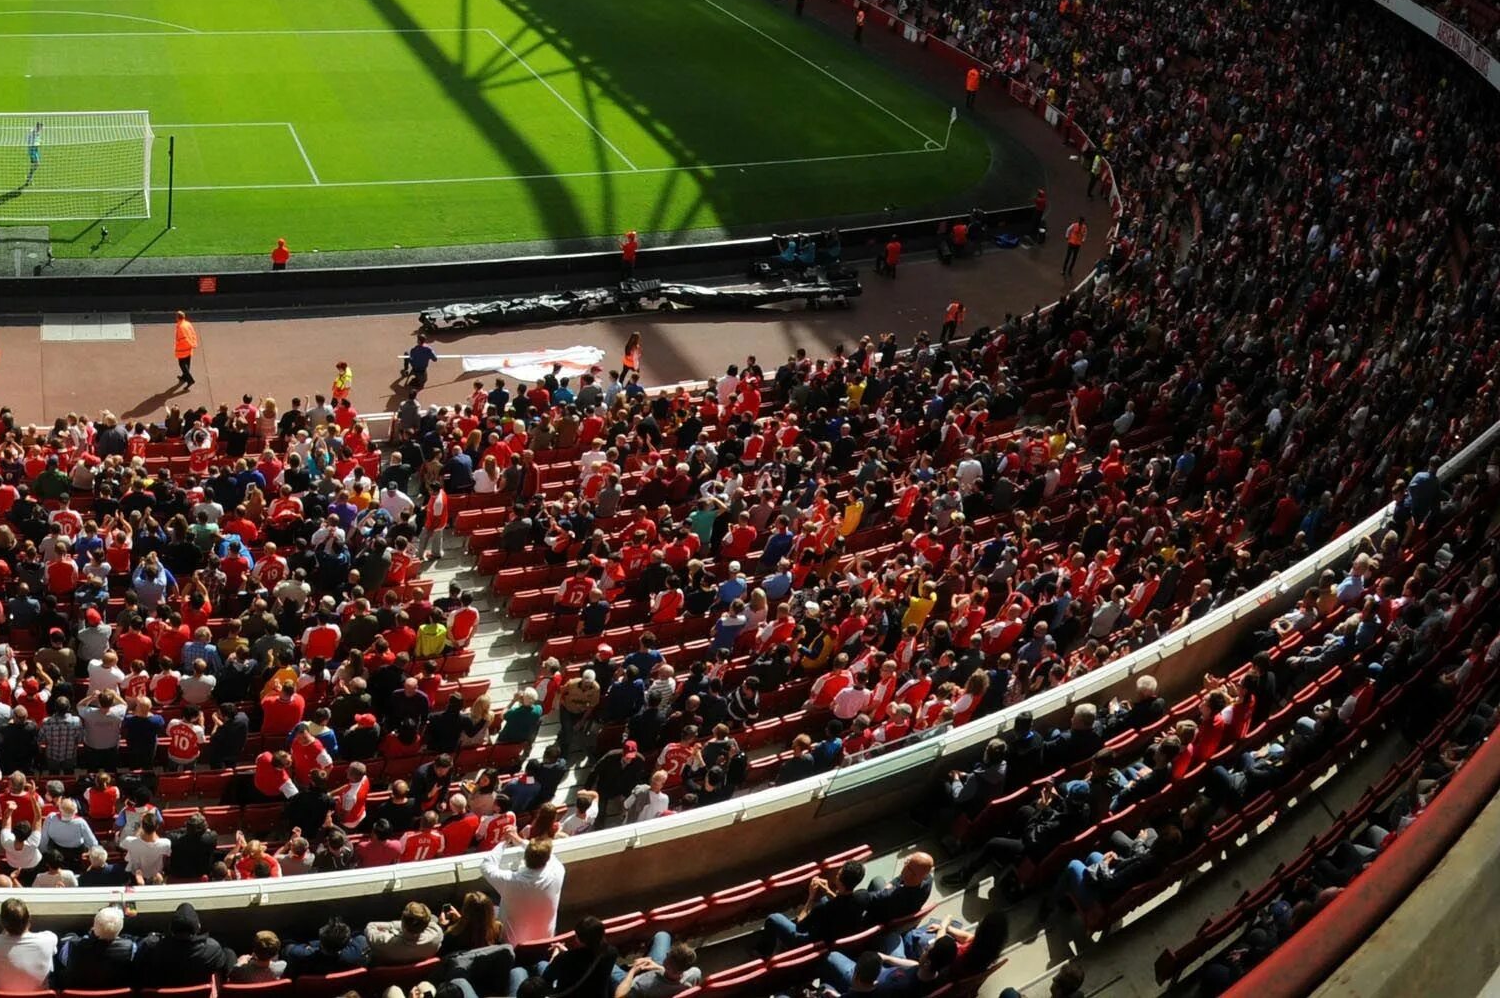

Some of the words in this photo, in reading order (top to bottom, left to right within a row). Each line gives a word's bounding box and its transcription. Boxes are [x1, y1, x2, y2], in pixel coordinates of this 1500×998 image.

[393, 562, 403, 573] 7
[570, 590, 584, 604] 12
[174, 735, 190, 751] 10
[415, 846, 430, 860] 11
